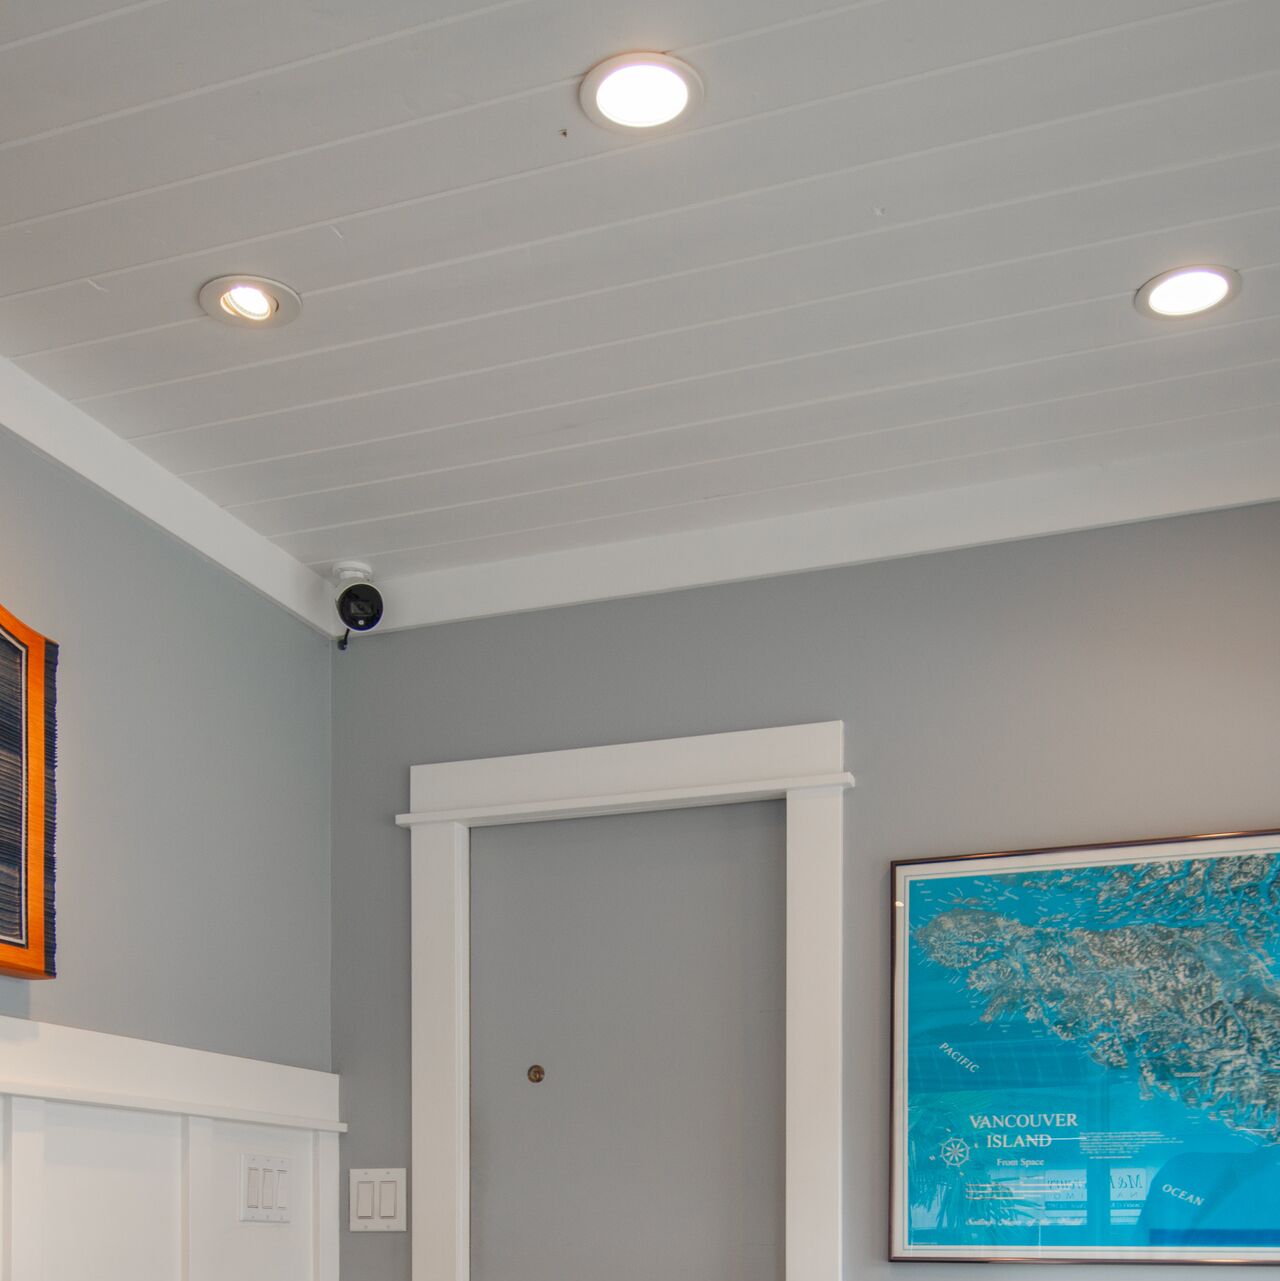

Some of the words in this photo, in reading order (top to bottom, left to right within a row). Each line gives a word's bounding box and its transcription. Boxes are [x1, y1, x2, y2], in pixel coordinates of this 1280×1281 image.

[939, 1042, 980, 1073] PACIFIC
[969, 1113, 1078, 1129] VANCOUVER
[987, 1134, 1052, 1149] ISLAND
[996, 1158, 1019, 1167] From
[1020, 1158, 1045, 1168] Space
[1162, 1183, 1205, 1206] OCEAN
